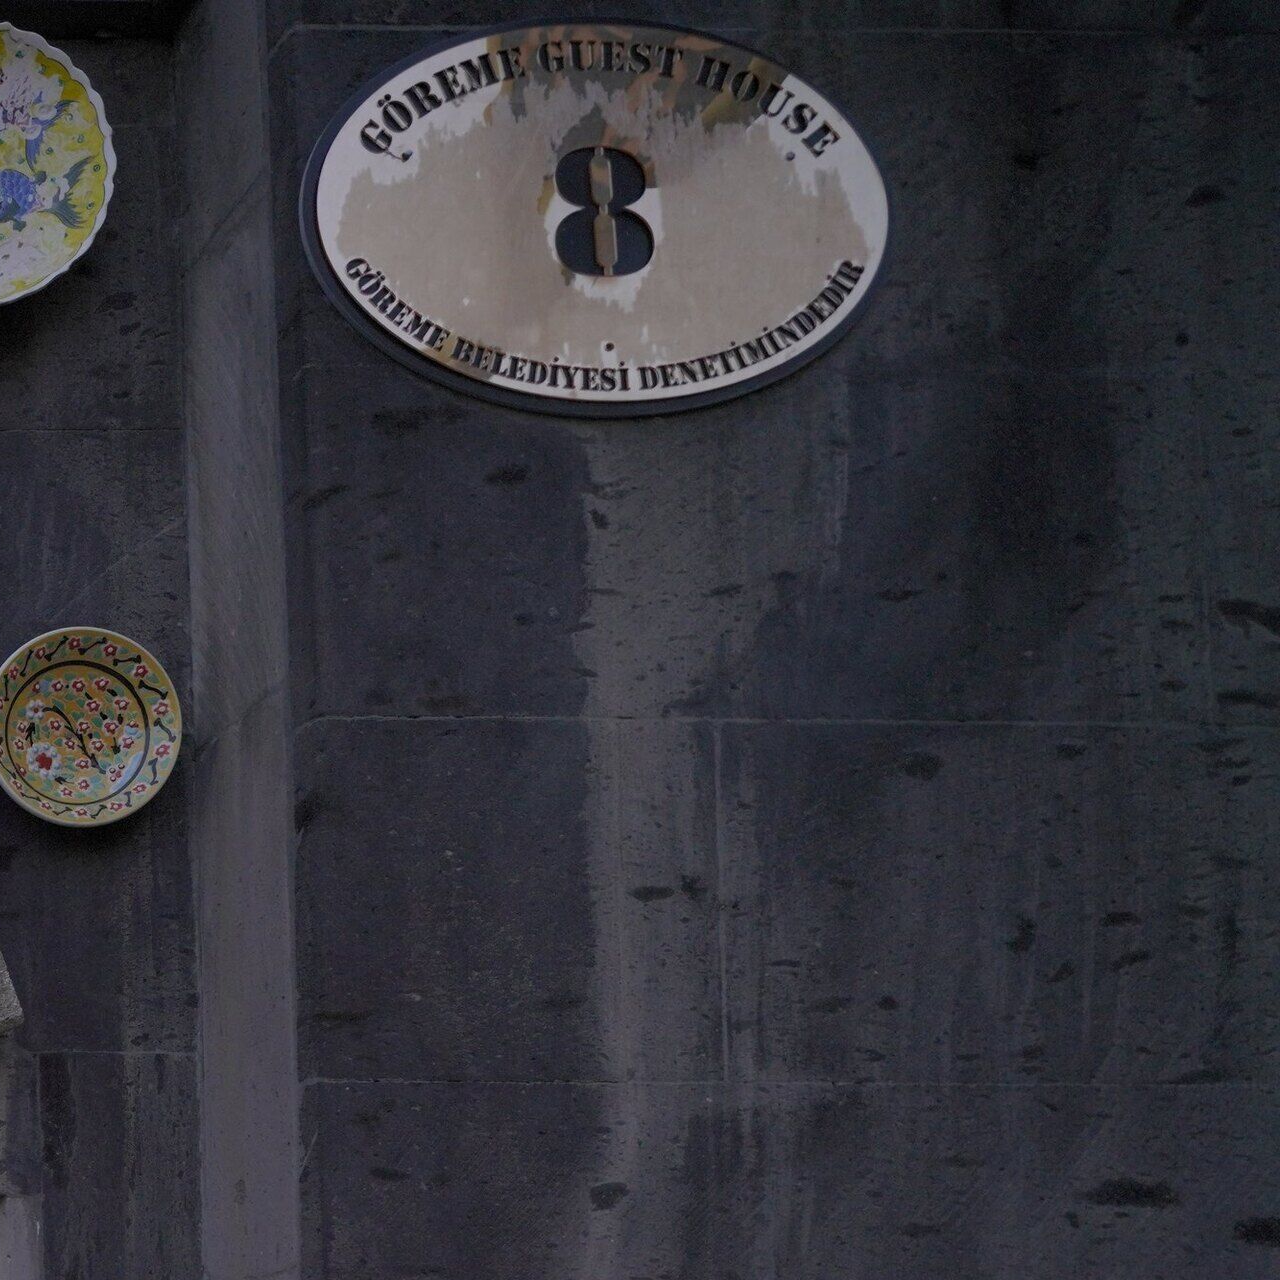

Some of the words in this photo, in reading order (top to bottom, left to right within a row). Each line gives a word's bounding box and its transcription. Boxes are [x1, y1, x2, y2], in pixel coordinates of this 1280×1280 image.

[360, 47, 525, 154] GÖREME
[537, 40, 683, 78] GUEST
[696, 57, 840, 158] HOUSE
[555, 148, 655, 276] 8
[346, 258, 451, 351] GÖREME
[451, 338, 630, 391] BELEDİYESİ
[638, 261, 864, 390] DENETİMİNDEDİR
